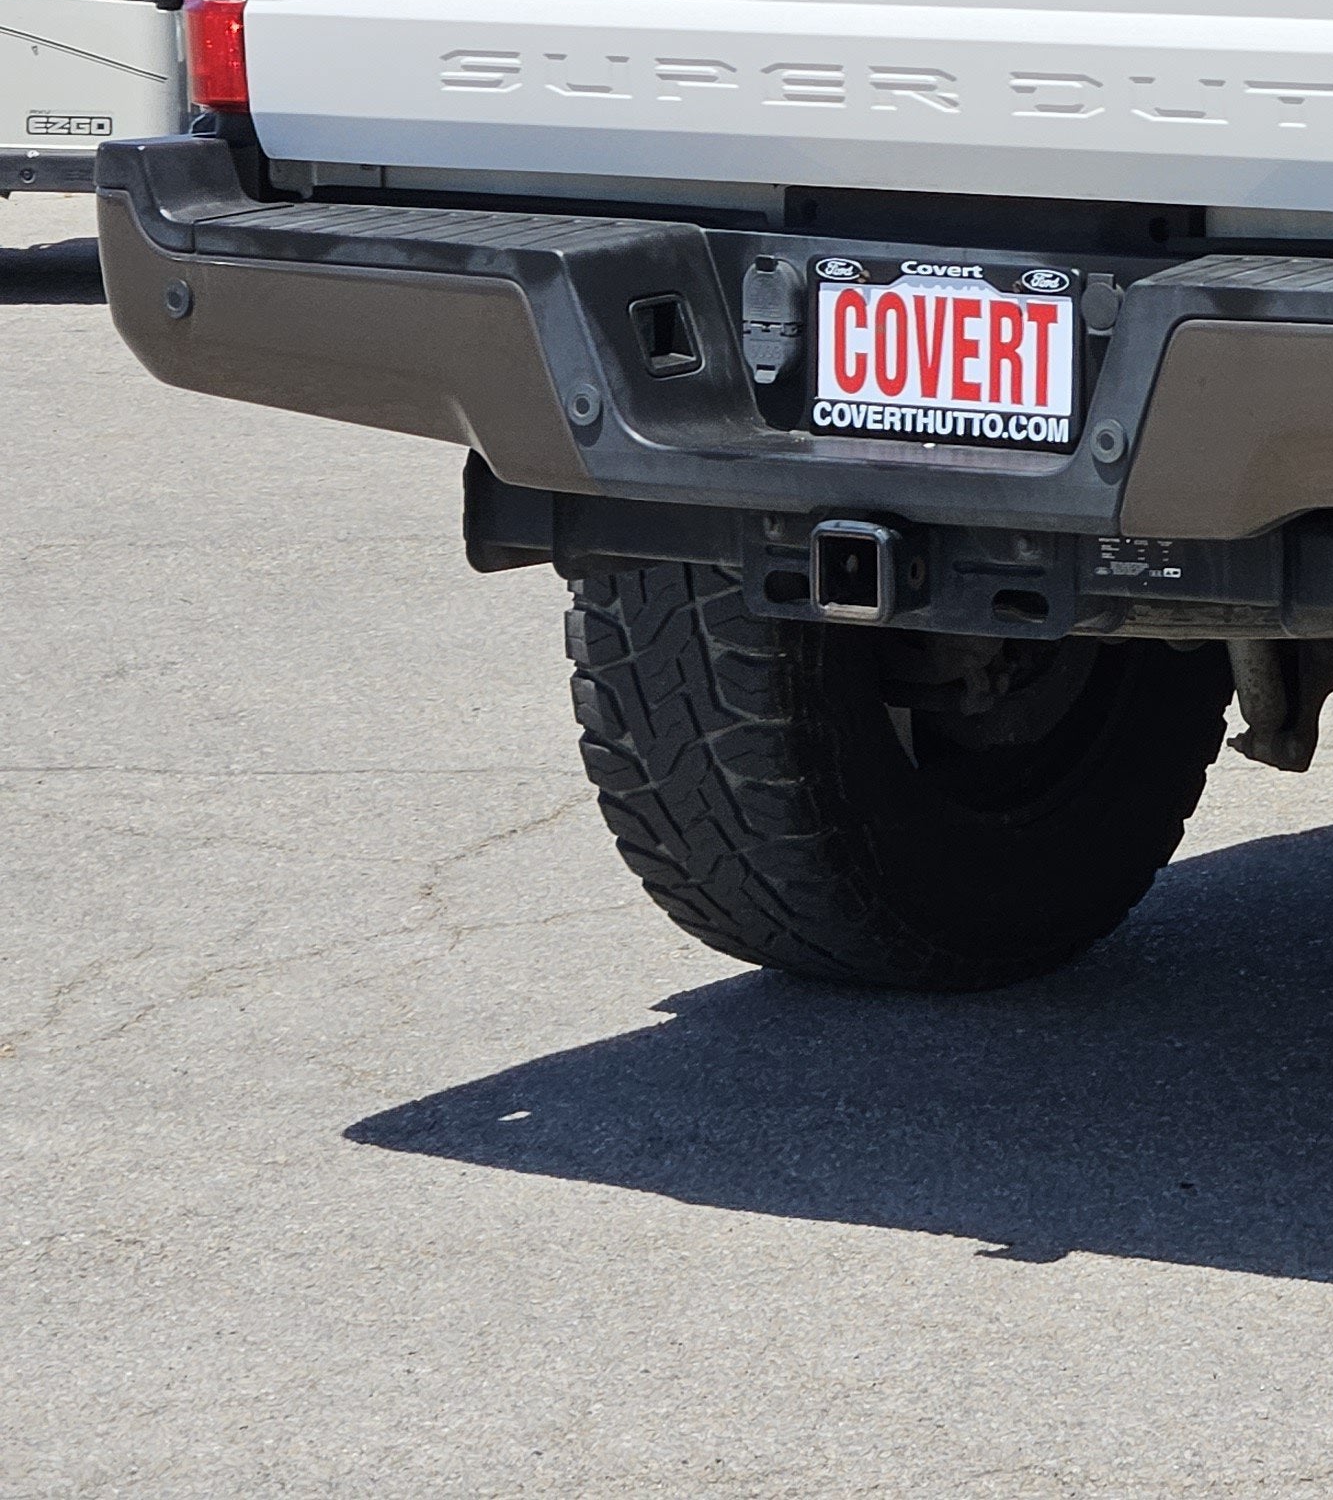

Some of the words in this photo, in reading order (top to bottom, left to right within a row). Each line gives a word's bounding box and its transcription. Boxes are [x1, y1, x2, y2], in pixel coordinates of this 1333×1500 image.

[440, 49, 962, 113] SUPER
[900, 260, 983, 278] Covert
[834, 287, 1059, 408] COVERT
[813, 401, 1069, 443] COVERTHUTTO.COM
